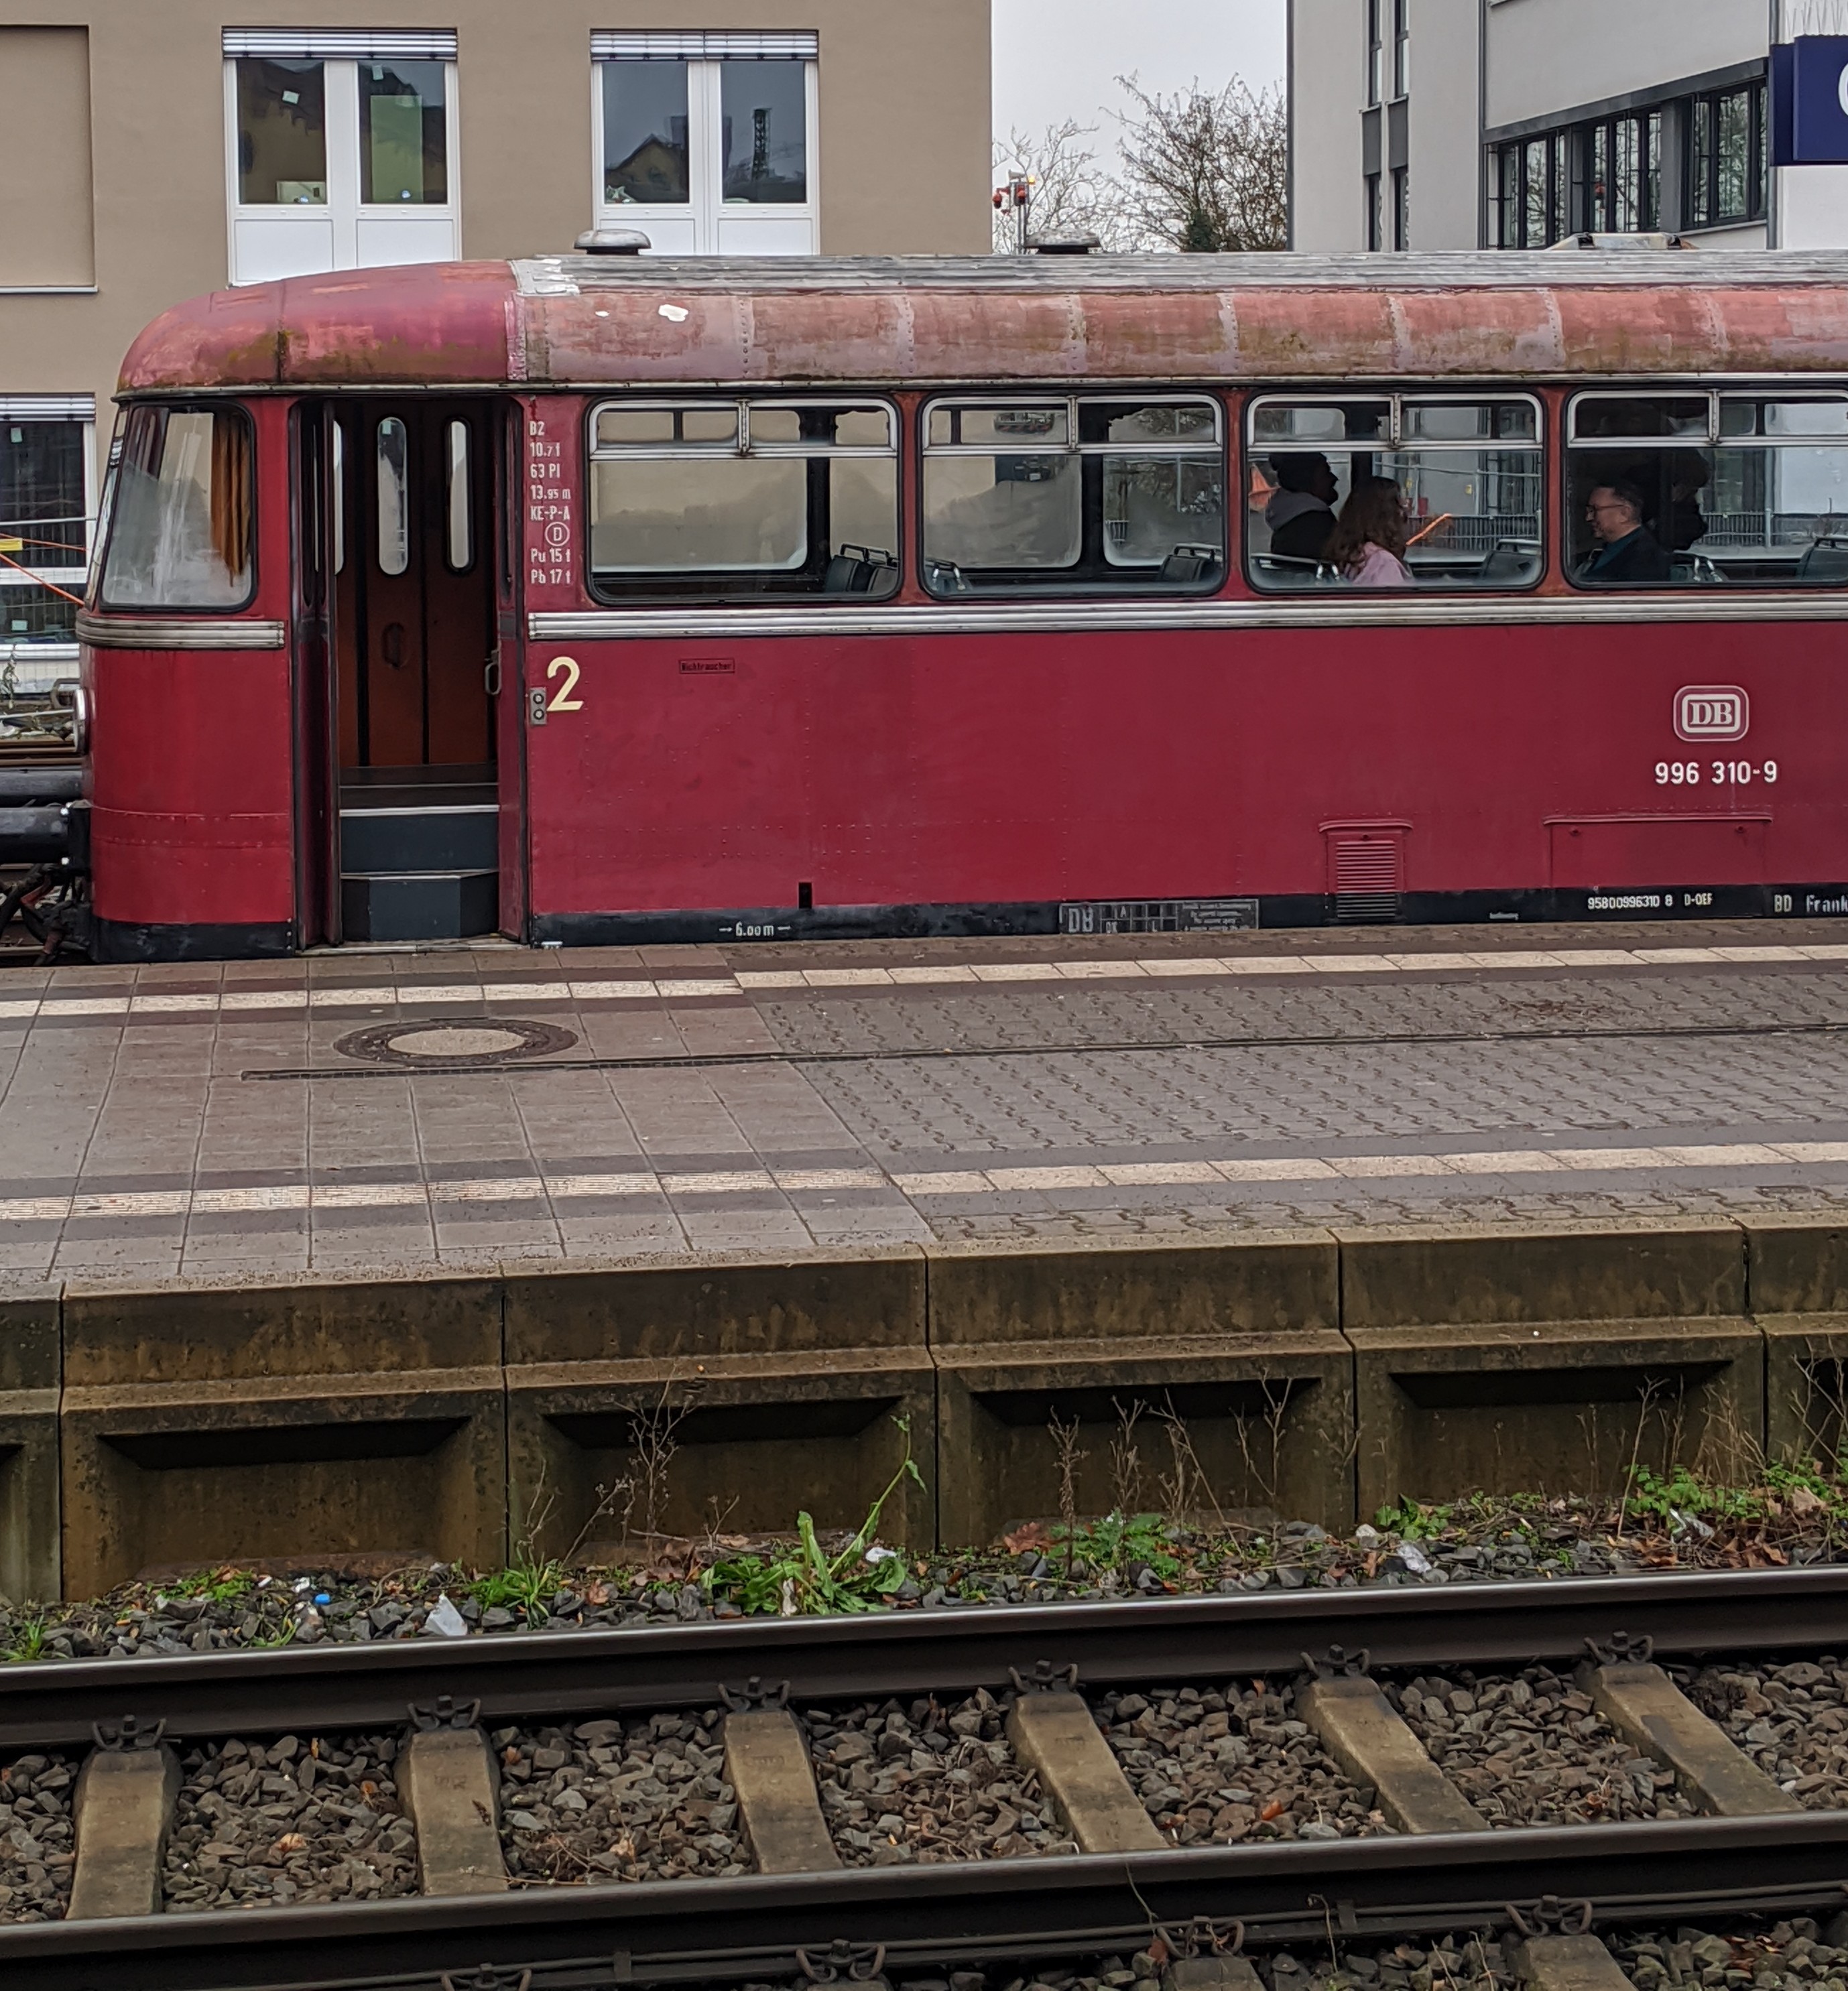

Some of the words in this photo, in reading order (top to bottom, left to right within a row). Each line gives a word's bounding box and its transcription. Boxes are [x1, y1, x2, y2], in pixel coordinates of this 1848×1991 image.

[530, 420, 545, 436] B2
[530, 442, 552, 457] 10.7
[530, 463, 545, 478] 63
[549, 463, 560, 478] Pl
[530, 485, 559, 500] 13.95
[562, 489, 571, 500] m
[530, 505, 570, 521] KE-P-A
[553, 527, 562, 541] D
[530, 548, 546, 563] Pu
[549, 548, 562, 563] 15
[531, 568, 546, 584] Pb
[549, 568, 562, 584] 17
[546, 656, 584, 712] 2
[1689, 702, 1733, 725] DB
[1655, 761, 1700, 784] 996
[1711, 760, 1777, 784] 310-9
[1587, 895, 1660, 910] 95800996310
[1664, 894, 1673, 907] 8
[1774, 894, 1792, 913] BD
